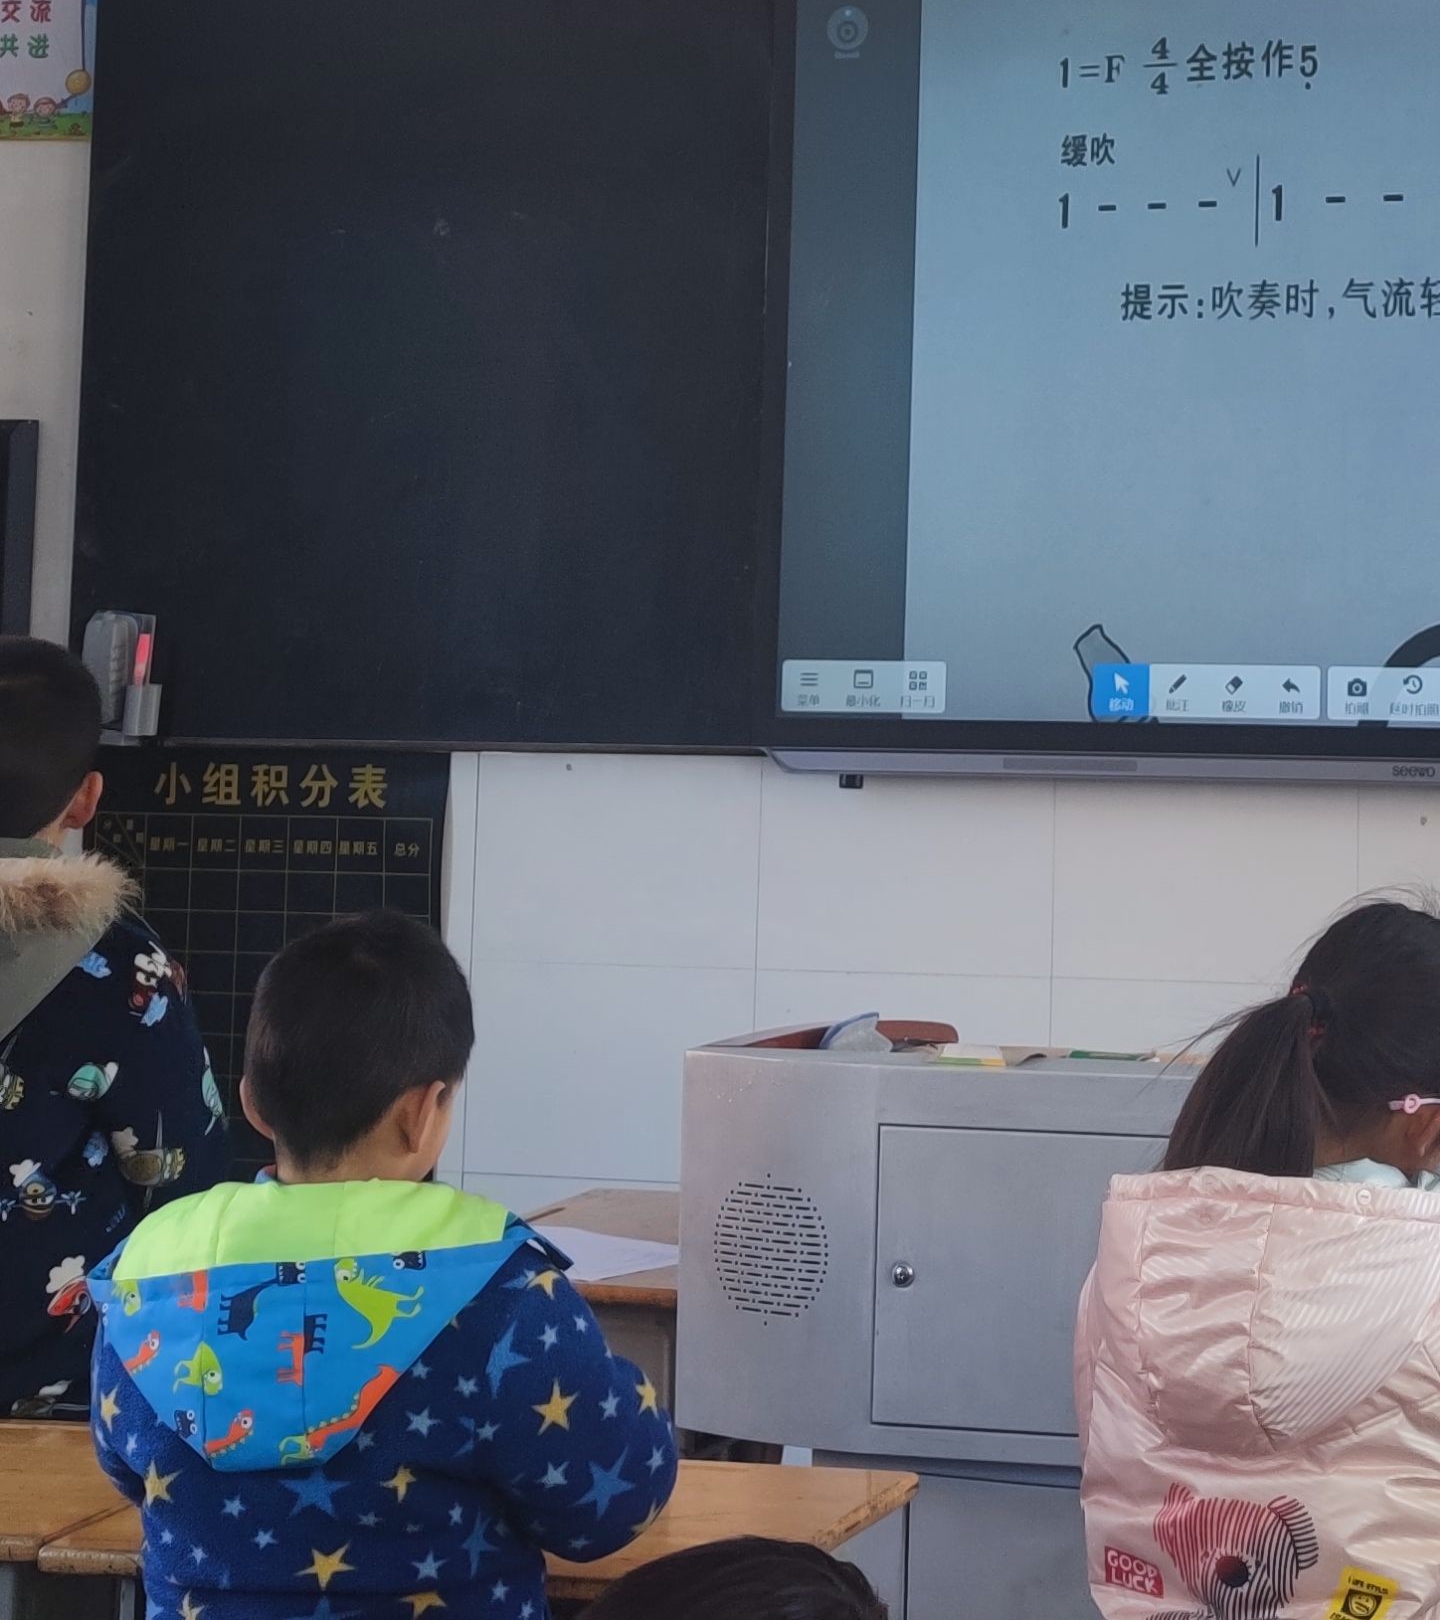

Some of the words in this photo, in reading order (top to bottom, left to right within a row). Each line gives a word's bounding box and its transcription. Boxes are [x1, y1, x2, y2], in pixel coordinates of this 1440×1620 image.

[1060, 133, 1116, 167] 缓吹
[1392, 765, 1435, 777] seewo
[155, 762, 389, 809] 小组积分表
[197, 837, 237, 853] 星期二
[293, 840, 332, 855] 星期四
[339, 840, 378, 855] 星期五
[394, 843, 420, 857] 总分
[1107, 1549, 1158, 1578] GOOD
[1111, 1567, 1159, 1594] LUCK
